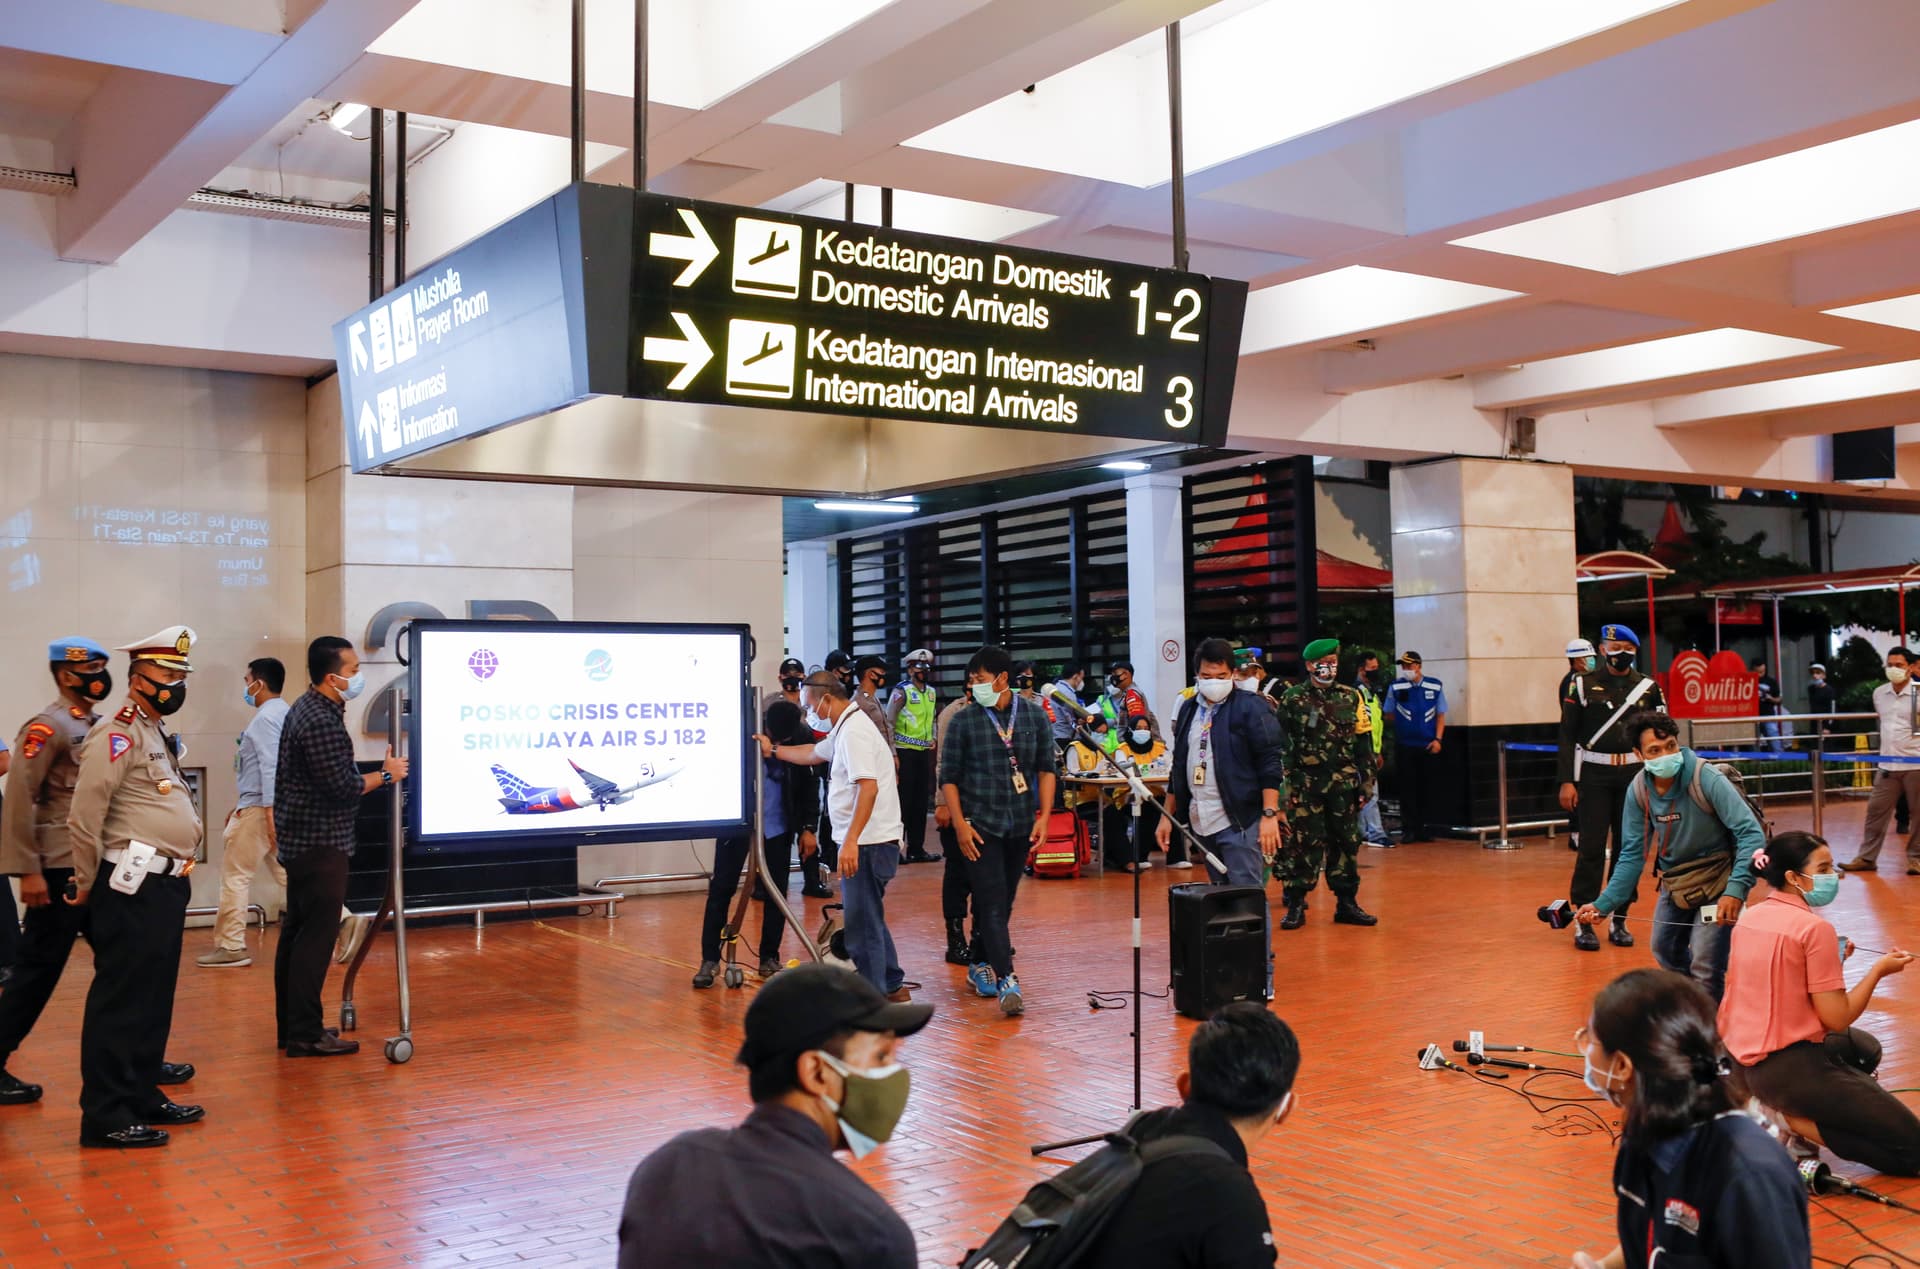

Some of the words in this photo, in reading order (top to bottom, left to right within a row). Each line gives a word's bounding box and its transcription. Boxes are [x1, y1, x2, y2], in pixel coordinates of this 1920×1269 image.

[415, 268, 462, 315] Musholla
[815, 229, 983, 284] Kedatangan
[993, 254, 1111, 300] Domestik
[417, 307, 452, 345] Prayer
[453, 290, 489, 328] Room
[811, 270, 944, 317] Domestic
[952, 289, 1049, 330] Arrivals
[1130, 282, 1201, 342] 1-2
[807, 328, 976, 379] Kedatangan
[987, 347, 1143, 393] Internasional
[400, 366, 447, 410] Informasi
[804, 369, 975, 415] International
[982, 386, 1078, 424] Arrivals
[1164, 375, 1194, 429] 3
[402, 405, 459, 446] Information
[460, 704, 540, 722] POSKO
[548, 703, 619, 721] CRISIS
[626, 702, 709, 719] CENTER
[463, 731, 594, 750] SRIWIJAYA
[601, 729, 637, 747] AIR
[643, 729, 667, 746] SJ
[674, 728, 706, 745] 182
